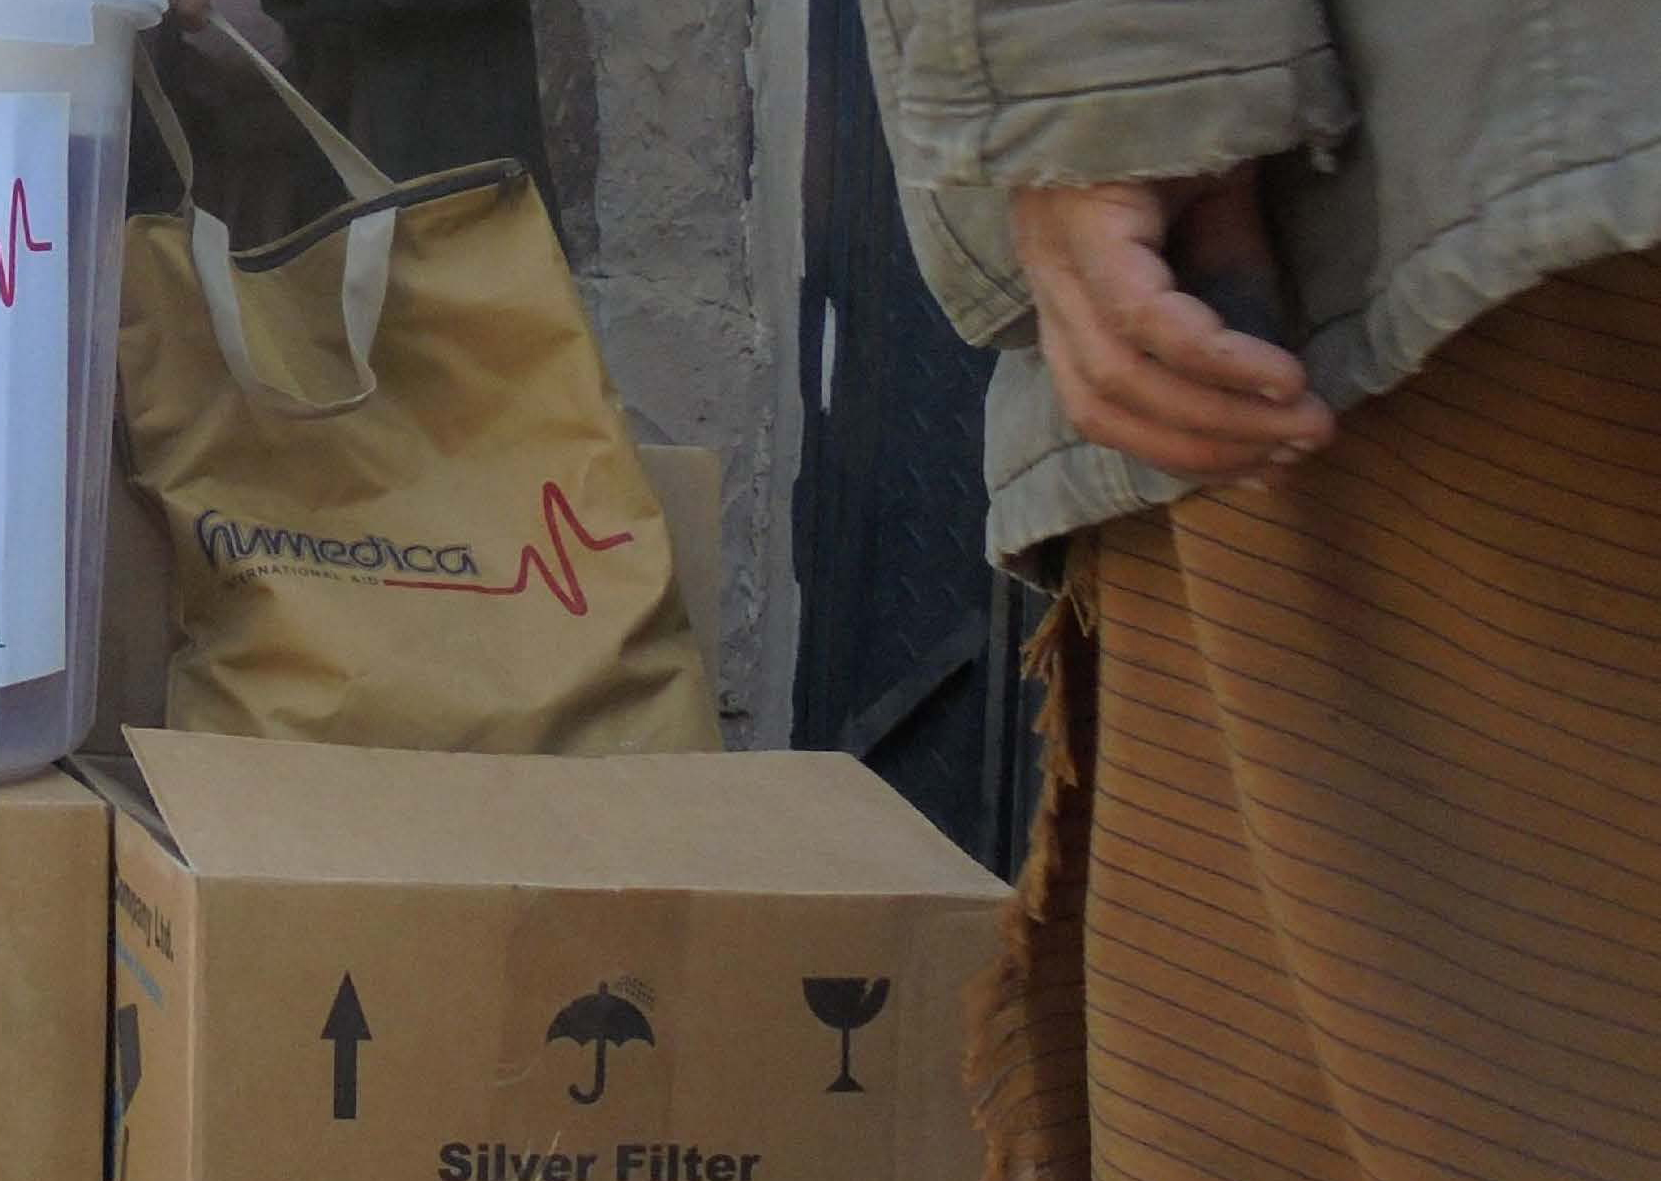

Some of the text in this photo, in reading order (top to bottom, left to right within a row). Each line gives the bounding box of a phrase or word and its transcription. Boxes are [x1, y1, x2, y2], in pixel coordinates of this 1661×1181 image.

[195, 510, 479, 578] humedica
[437, 1142, 763, 1181] Silver Filter
